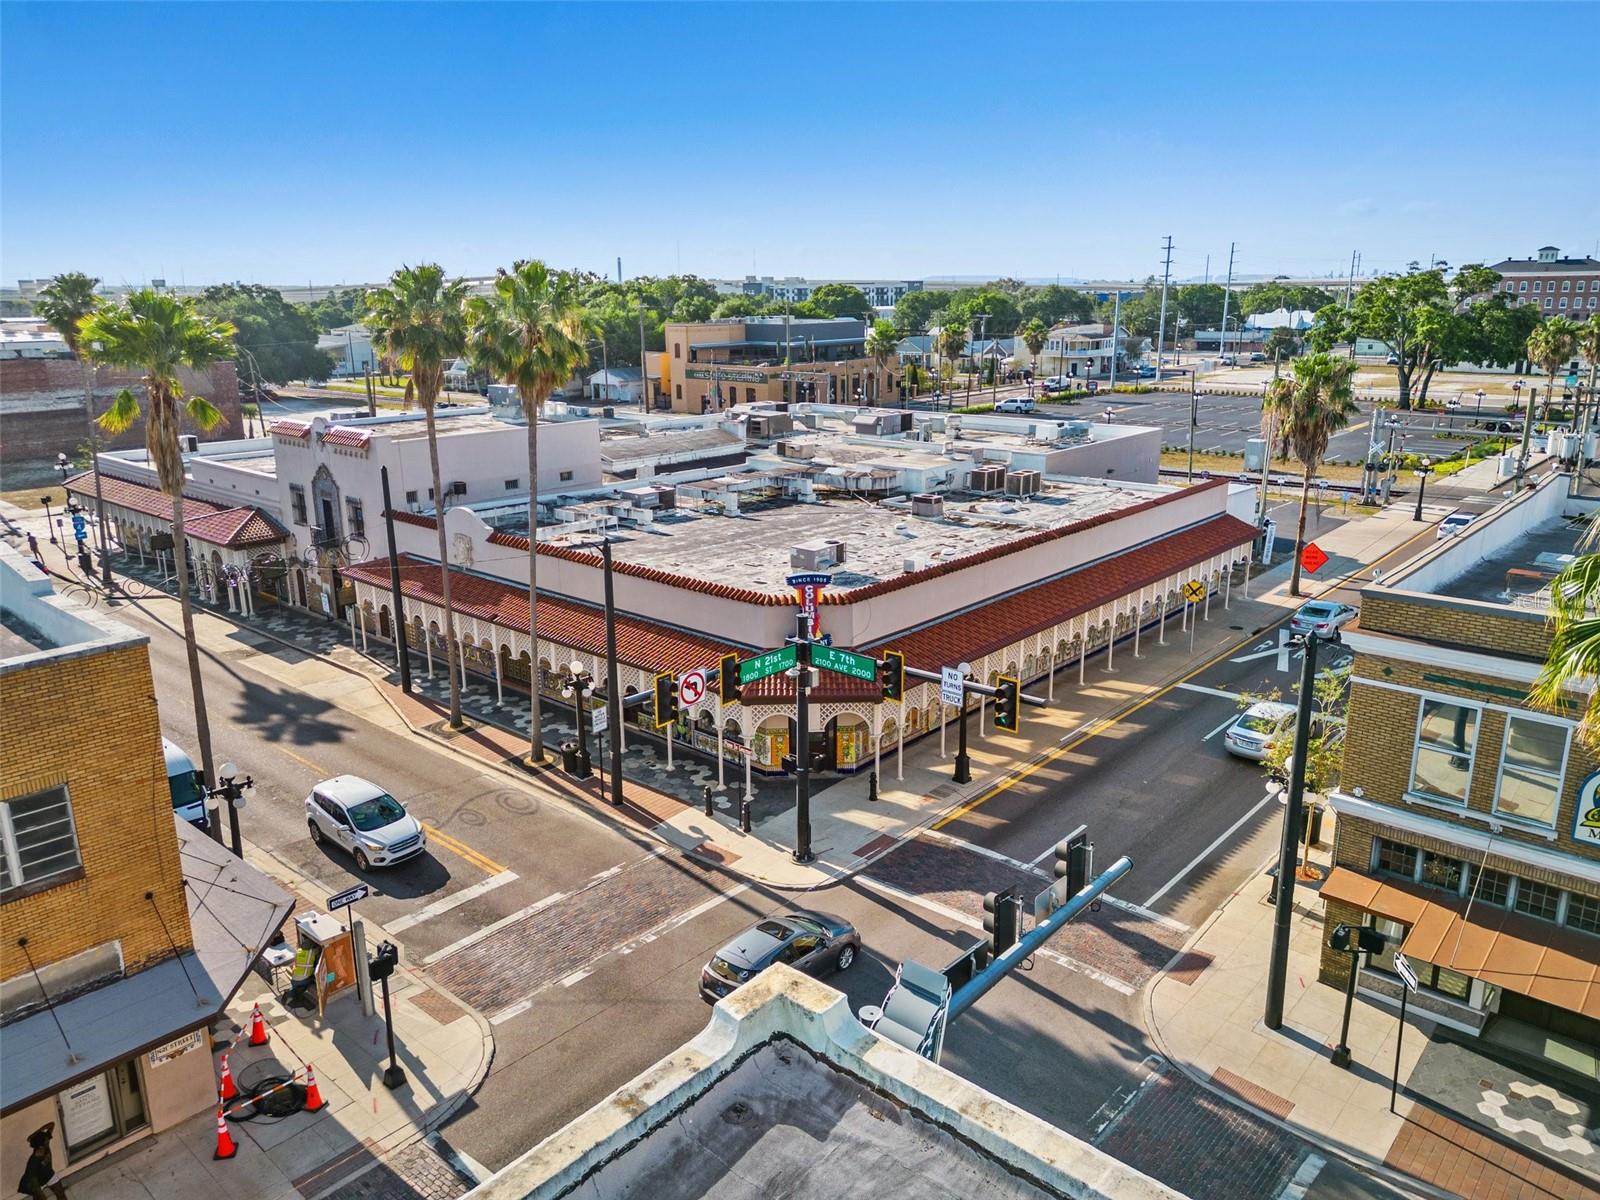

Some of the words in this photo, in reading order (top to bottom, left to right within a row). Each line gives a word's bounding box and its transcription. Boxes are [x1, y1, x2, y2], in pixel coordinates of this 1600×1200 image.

[754, 659, 761, 670] N
[764, 653, 782, 666] 21st
[829, 650, 836, 660] E
[839, 653, 856, 666] 7th
[743, 671, 759, 682] 1800
[765, 665, 773, 674] ST
[779, 659, 794, 669] 1700
[815, 657, 832, 668] 2100
[833, 663, 848, 672] AVE
[851, 667, 872, 679] 2000
[948, 672, 958, 681] NO
[944, 681, 962, 691] TURNS
[345, 894, 356, 902] WAY
